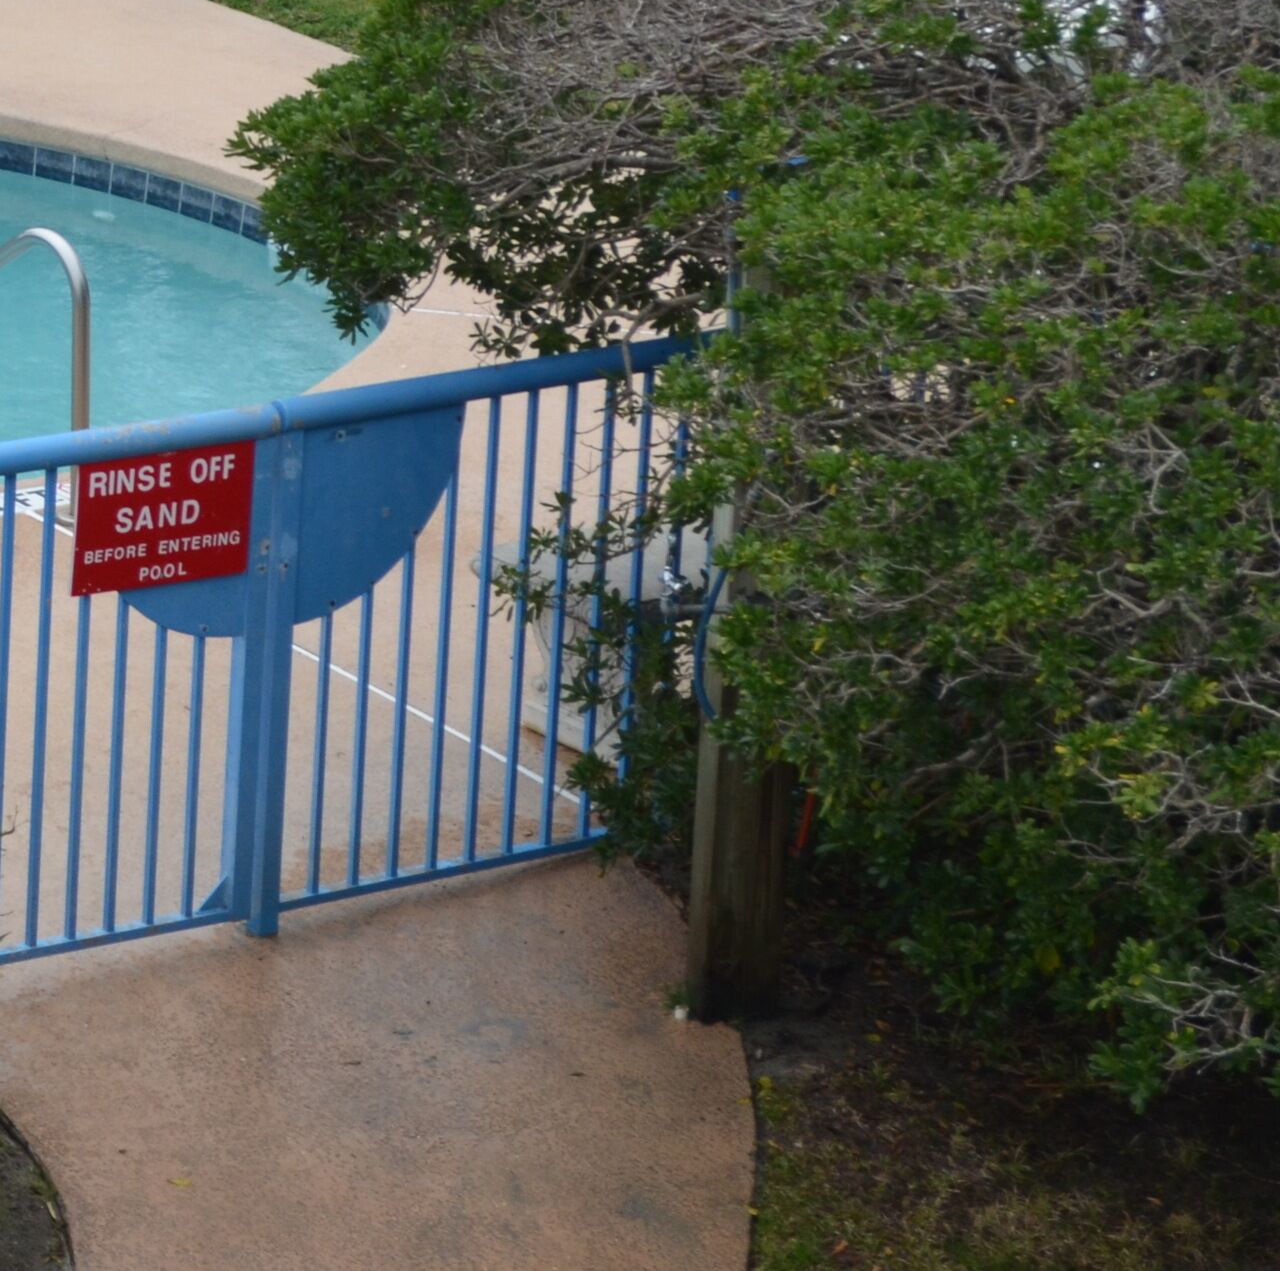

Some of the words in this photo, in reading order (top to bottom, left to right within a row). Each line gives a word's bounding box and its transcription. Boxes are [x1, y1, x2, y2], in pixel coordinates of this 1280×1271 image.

[89, 462, 172, 498] RINSE
[190, 454, 236, 484] OFF
[115, 499, 200, 533] SAND
[84, 543, 147, 565] BEFORE
[158, 530, 241, 555] ENTERING
[139, 562, 188, 581] POOL
